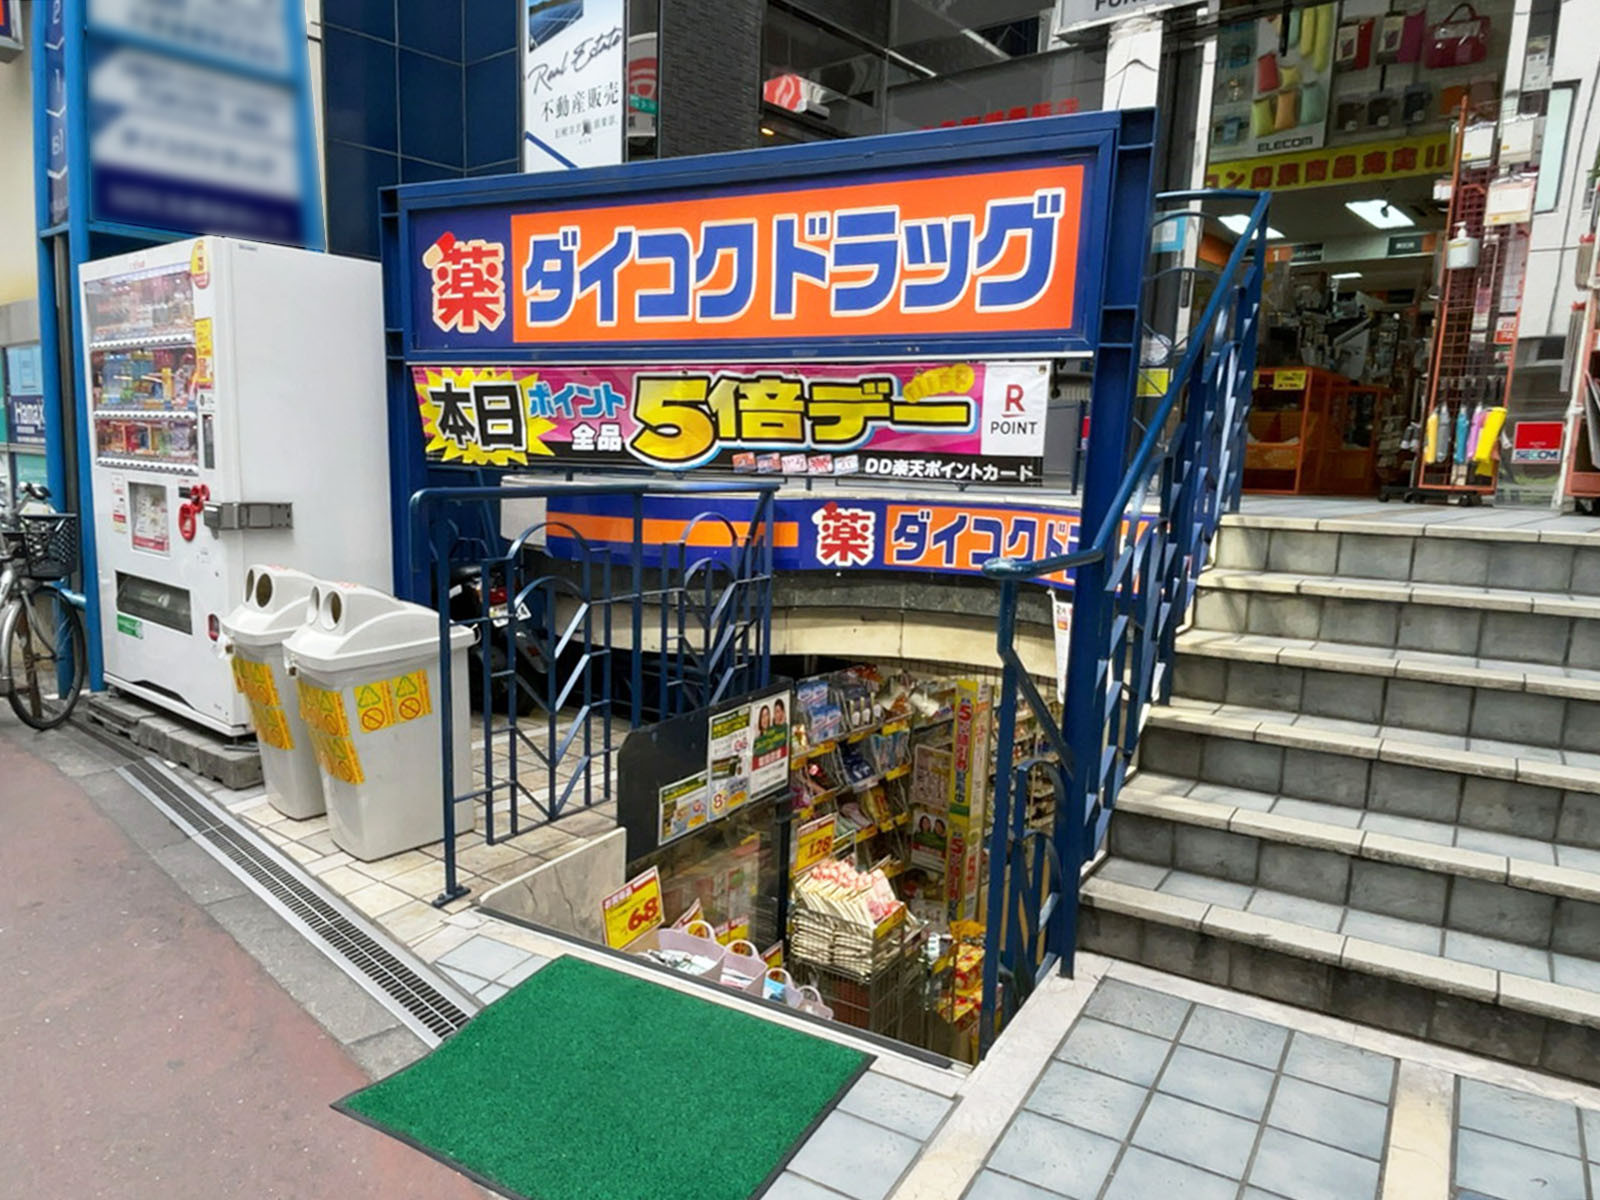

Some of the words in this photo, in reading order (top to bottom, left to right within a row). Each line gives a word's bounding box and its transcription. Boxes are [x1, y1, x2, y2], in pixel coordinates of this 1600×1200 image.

[528, 50, 569, 95] Real
[541, 82, 619, 122] 不動産販売
[1257, 136, 1313, 152] ELECOM
[424, 233, 505, 332] 薬
[523, 187, 1065, 328] ダイコクドラッグ
[1004, 384, 1024, 416] R
[428, 378, 527, 451] 本日
[527, 380, 626, 418] ポイント
[628, 374, 973, 464] 5倍デー
[990, 420, 1038, 436] POINT
[571, 422, 622, 452] 全品
[865, 457, 1034, 482] DD楽天ポイントカード
[813, 502, 876, 566] 薬
[808, 836, 832, 859] 128
[627, 896, 659, 931] 68
